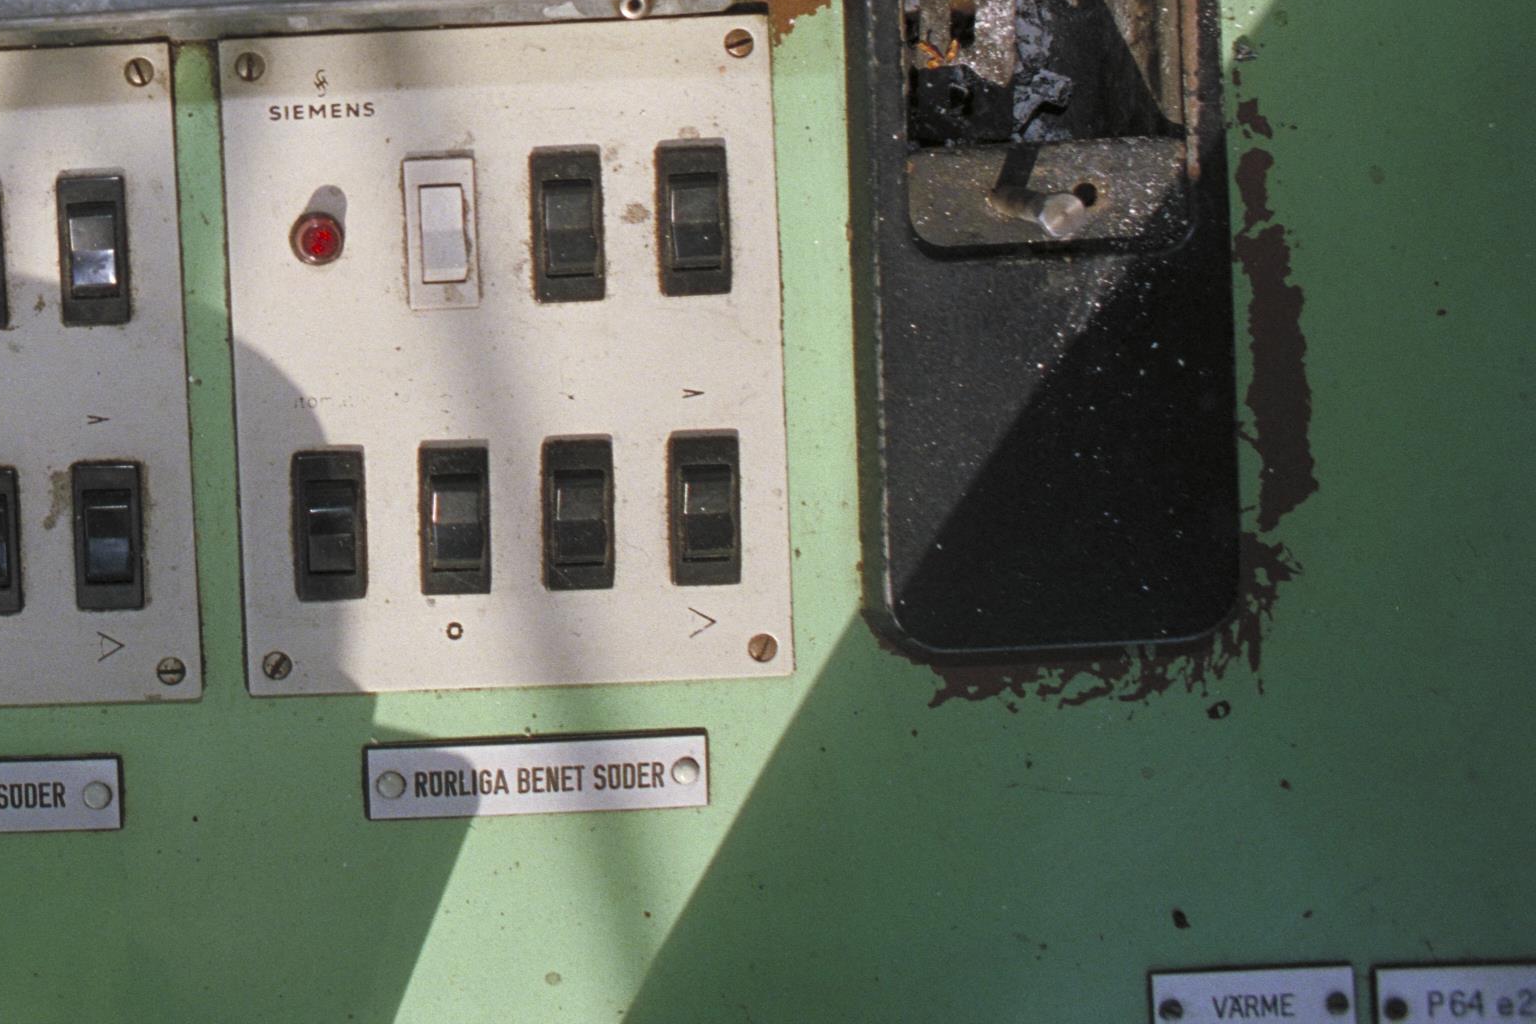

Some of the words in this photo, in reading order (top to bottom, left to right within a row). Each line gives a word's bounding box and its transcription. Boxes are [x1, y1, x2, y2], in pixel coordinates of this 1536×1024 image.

[268, 101, 376, 122] SIEMENS
[516, 764, 585, 795] BENET
[1211, 992, 1296, 1019] VÄRME
